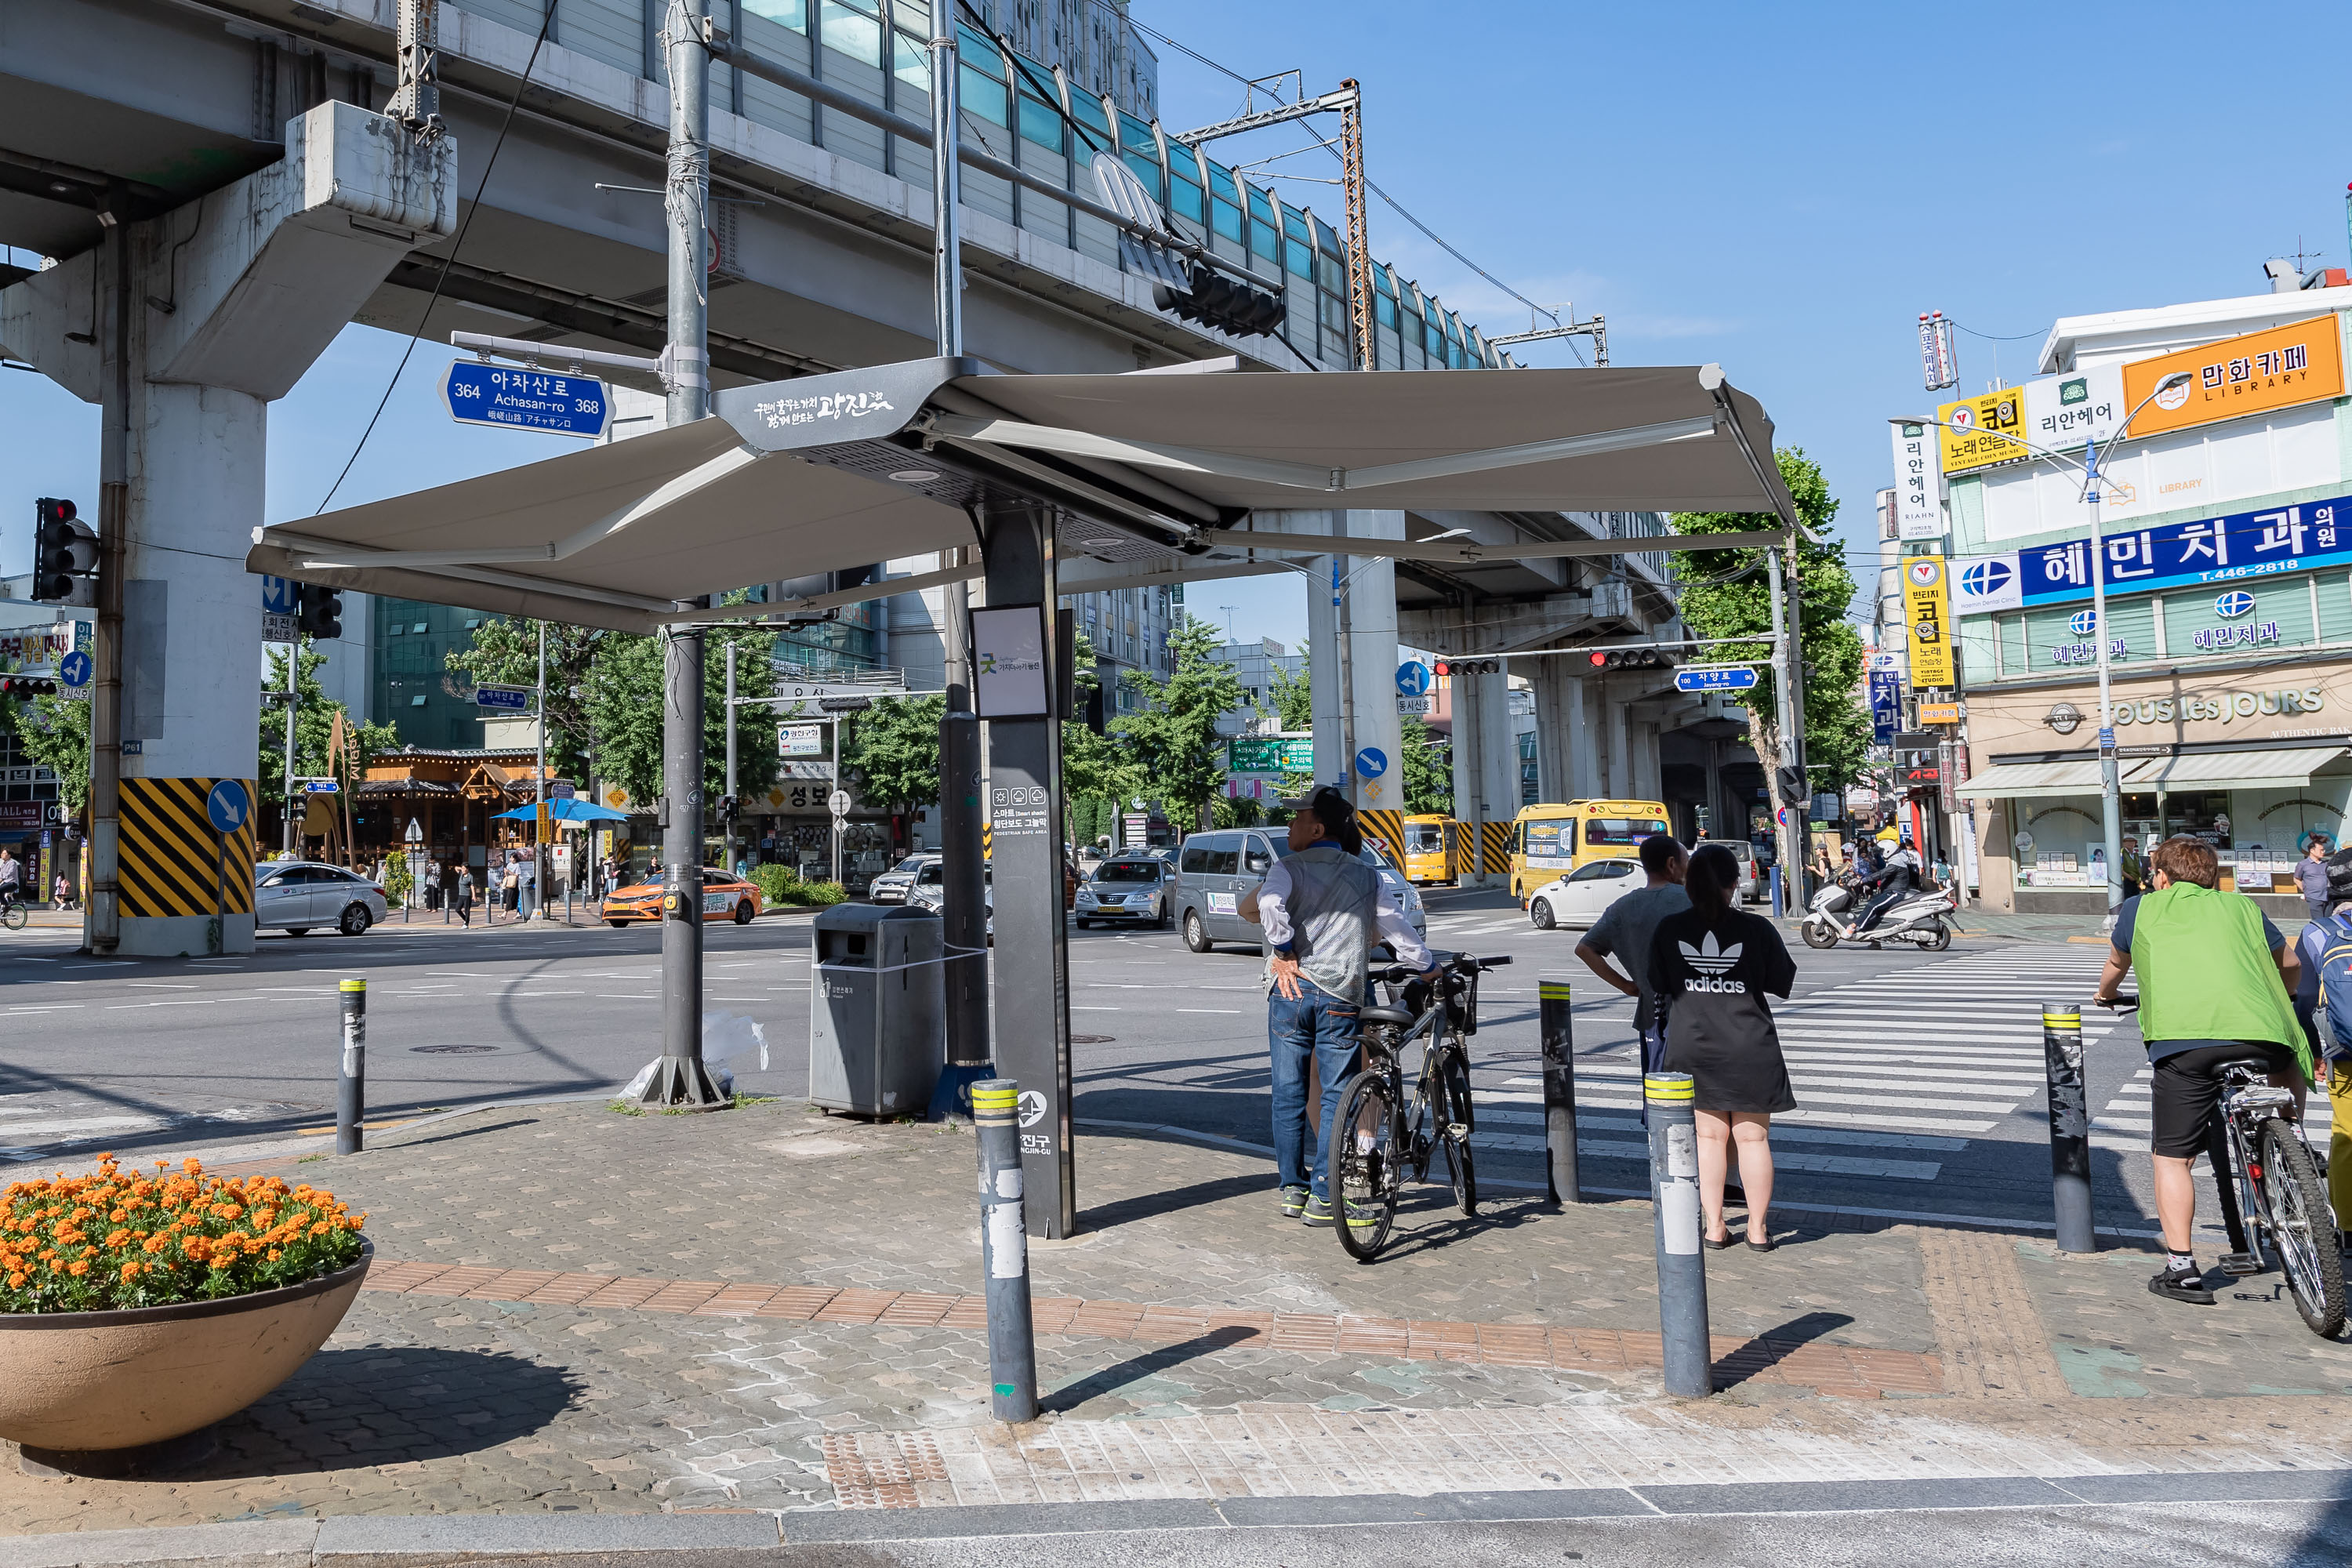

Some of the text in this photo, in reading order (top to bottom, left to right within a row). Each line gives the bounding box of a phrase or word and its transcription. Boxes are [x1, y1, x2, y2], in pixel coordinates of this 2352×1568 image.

[1922, 326, 1936, 383] 스포츠마사지
[2202, 344, 2307, 390] 만화카페
[455, 383, 481, 399] 364
[492, 372, 569, 397] 아차산로
[2205, 371, 2307, 401] LIBRARY
[495, 393, 565, 412] Achasan-ro
[575, 398, 599, 414] 368
[800, 397, 818, 409] 가치
[1980, 398, 1998, 407] 빈티지
[792, 412, 815, 426] 만드는
[2042, 403, 2112, 433] 리안헤어
[1951, 438, 1977, 459] 노래
[1951, 457, 1978, 466] VINTAGE
[1907, 442, 1925, 507] 리안헤어
[2159, 478, 2202, 494] LIBRARY
[2043, 506, 2336, 586] 혜민치과 의원
[2199, 559, 2299, 582] T.446-2818
[1913, 590, 1939, 600] 빈티지
[1961, 596, 2016, 609] Haemin Dental Clinic
[262, 628, 299, 641] 행신호시
[2194, 622, 2280, 650] 혜민치과
[1920, 647, 1942, 657] 노래
[1698, 672, 1731, 681] 자양로
[1873, 673, 1897, 683] 혜민
[58, 688, 89, 699] 동시신호
[487, 691, 515, 701] 아차산로
[1399, 700, 1430, 711] 동시신호
[1875, 684, 1901, 729] 치과
[2180, 697, 2220, 722] les
[2223, 687, 2324, 725] JOURS
[1923, 709, 1955, 718] 만화카페
[2270, 727, 2327, 739] AUTHENTIC
[1942, 760, 1953, 808] 발마사지
[993, 809, 1014, 818] 스마트
[993, 818, 1047, 829] 횡단보도 그늘막
[1685, 976, 1746, 993] adidas
[1020, 1134, 1051, 1147] 진구
